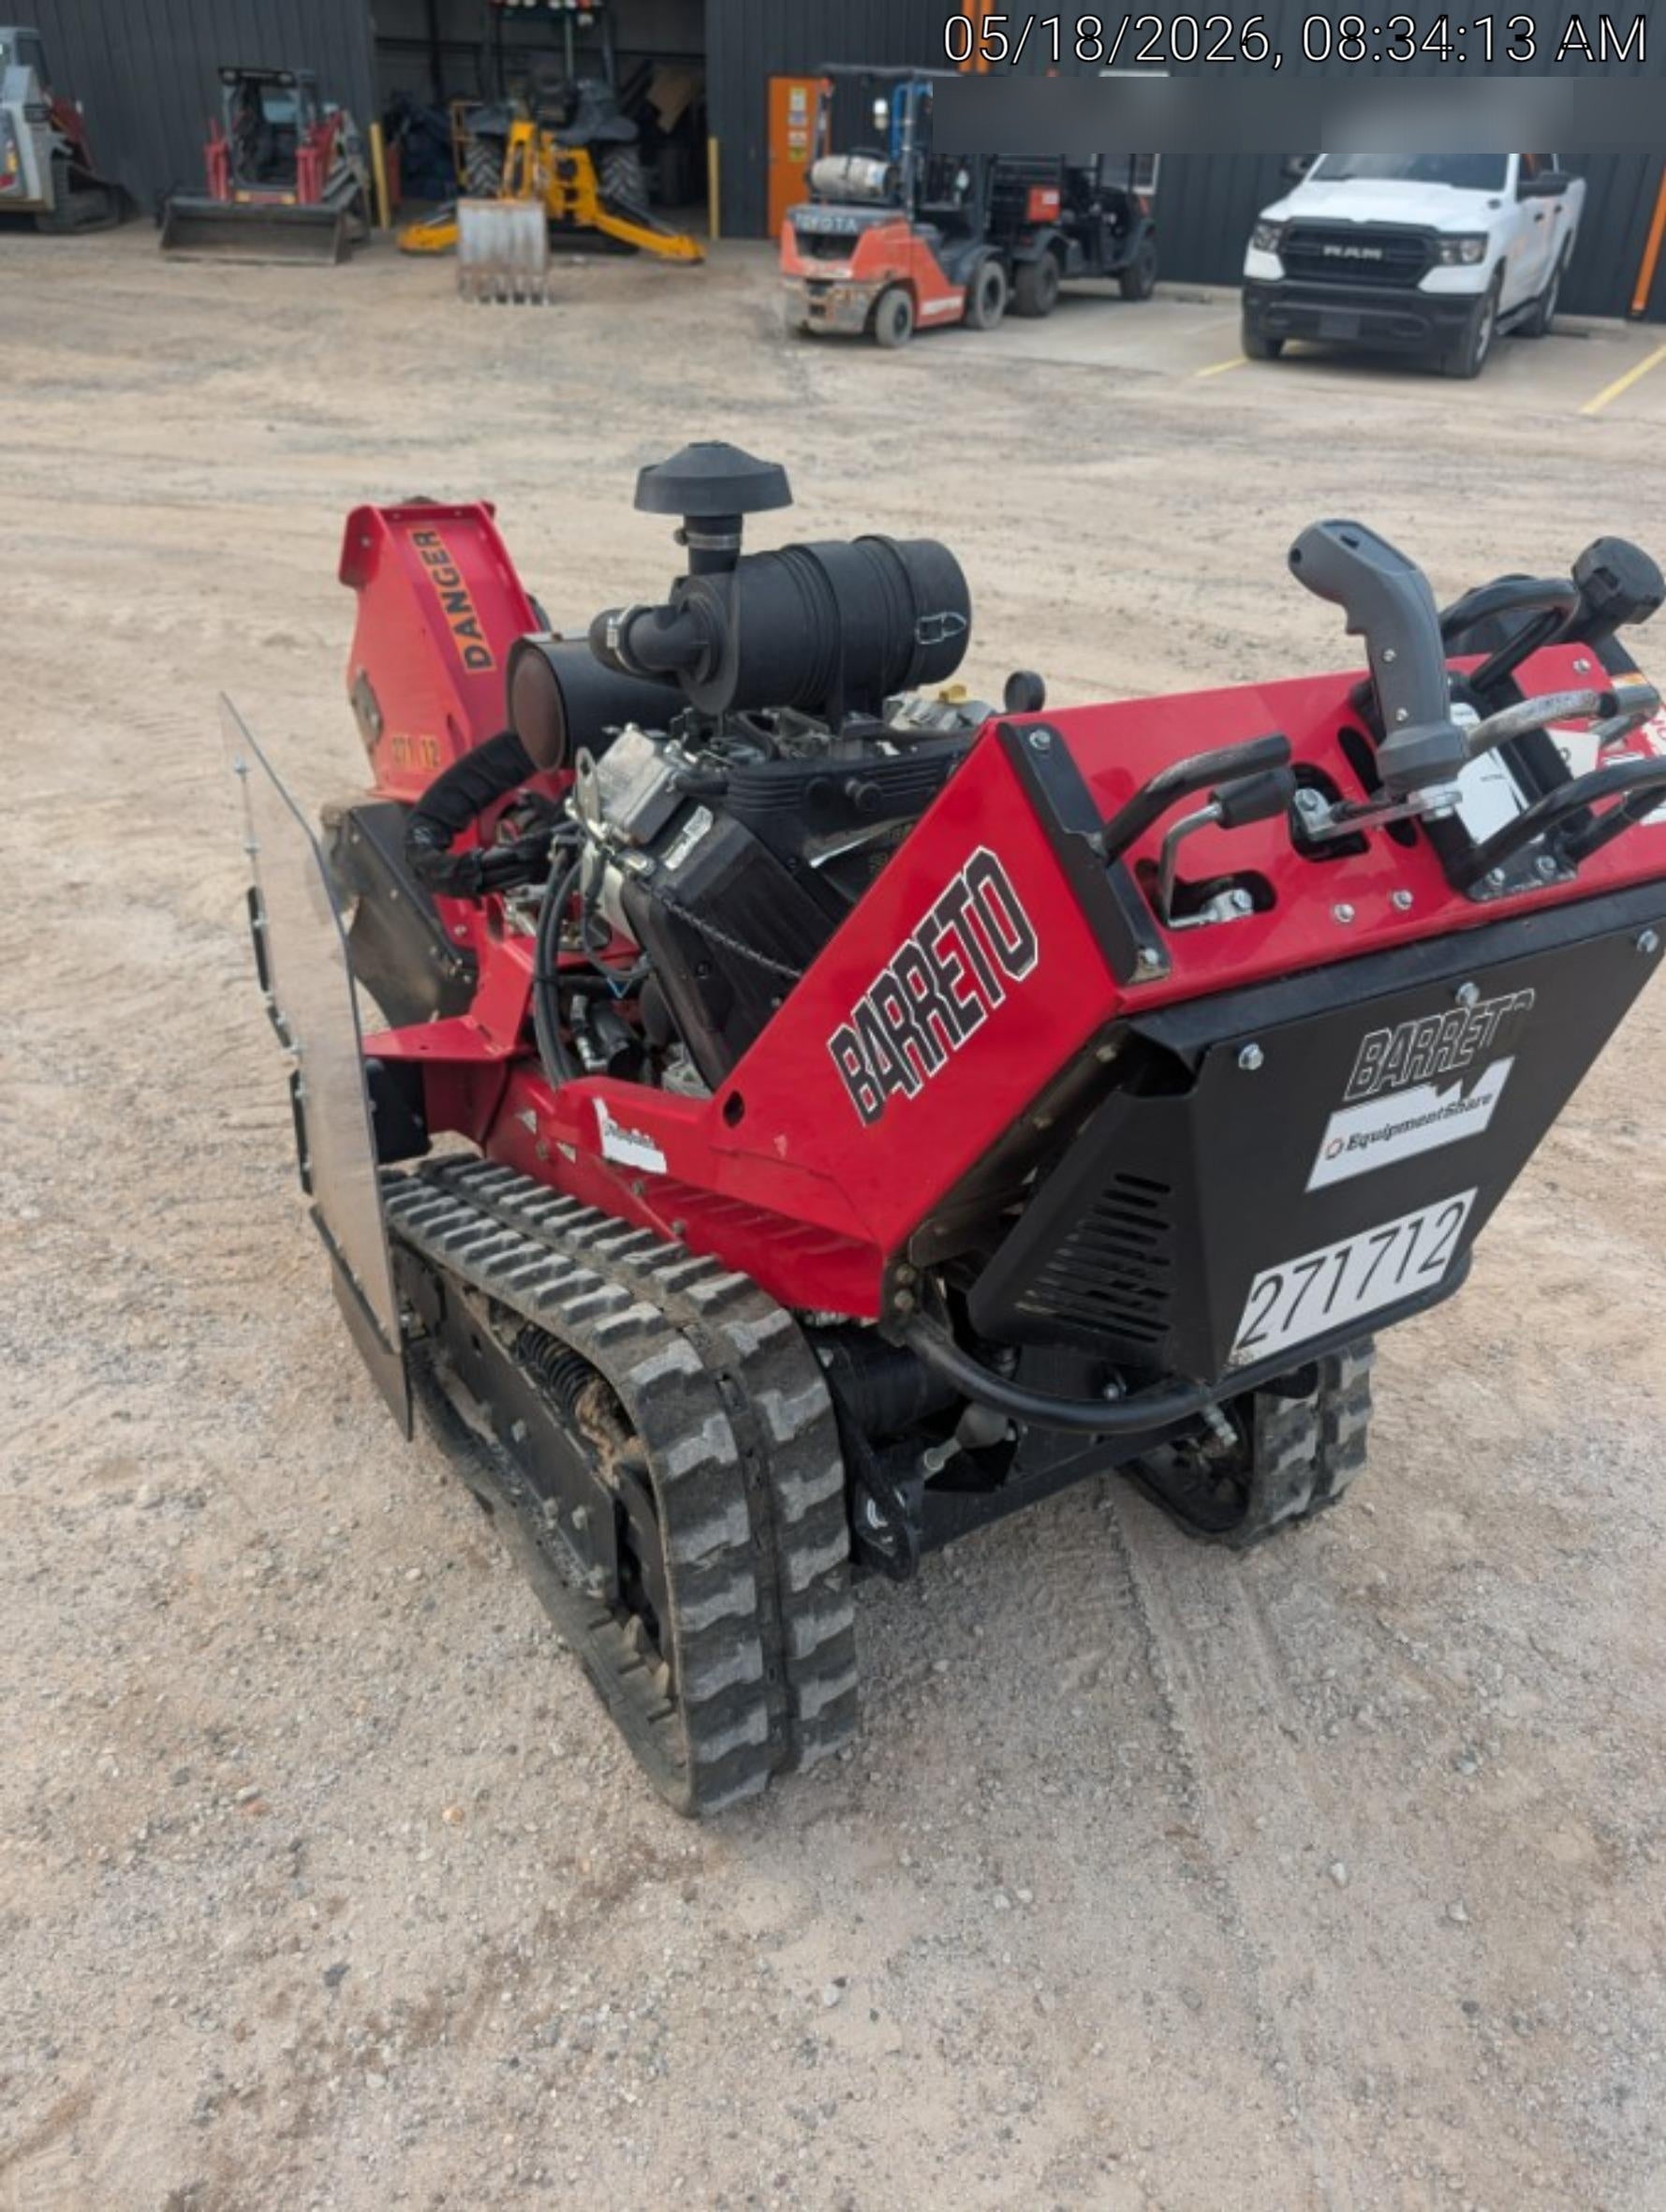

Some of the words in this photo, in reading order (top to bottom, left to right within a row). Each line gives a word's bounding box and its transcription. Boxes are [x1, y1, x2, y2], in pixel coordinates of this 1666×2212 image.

[1322, 244, 1382, 260] RAM
[412, 530, 493, 670] DANGER
[827, 845, 1039, 1128] BARRETO
[1343, 988, 1535, 1102] BARRET
[1346, 1092, 1494, 1152] EquipmentShare
[1236, 1201, 1465, 1350] 271712
